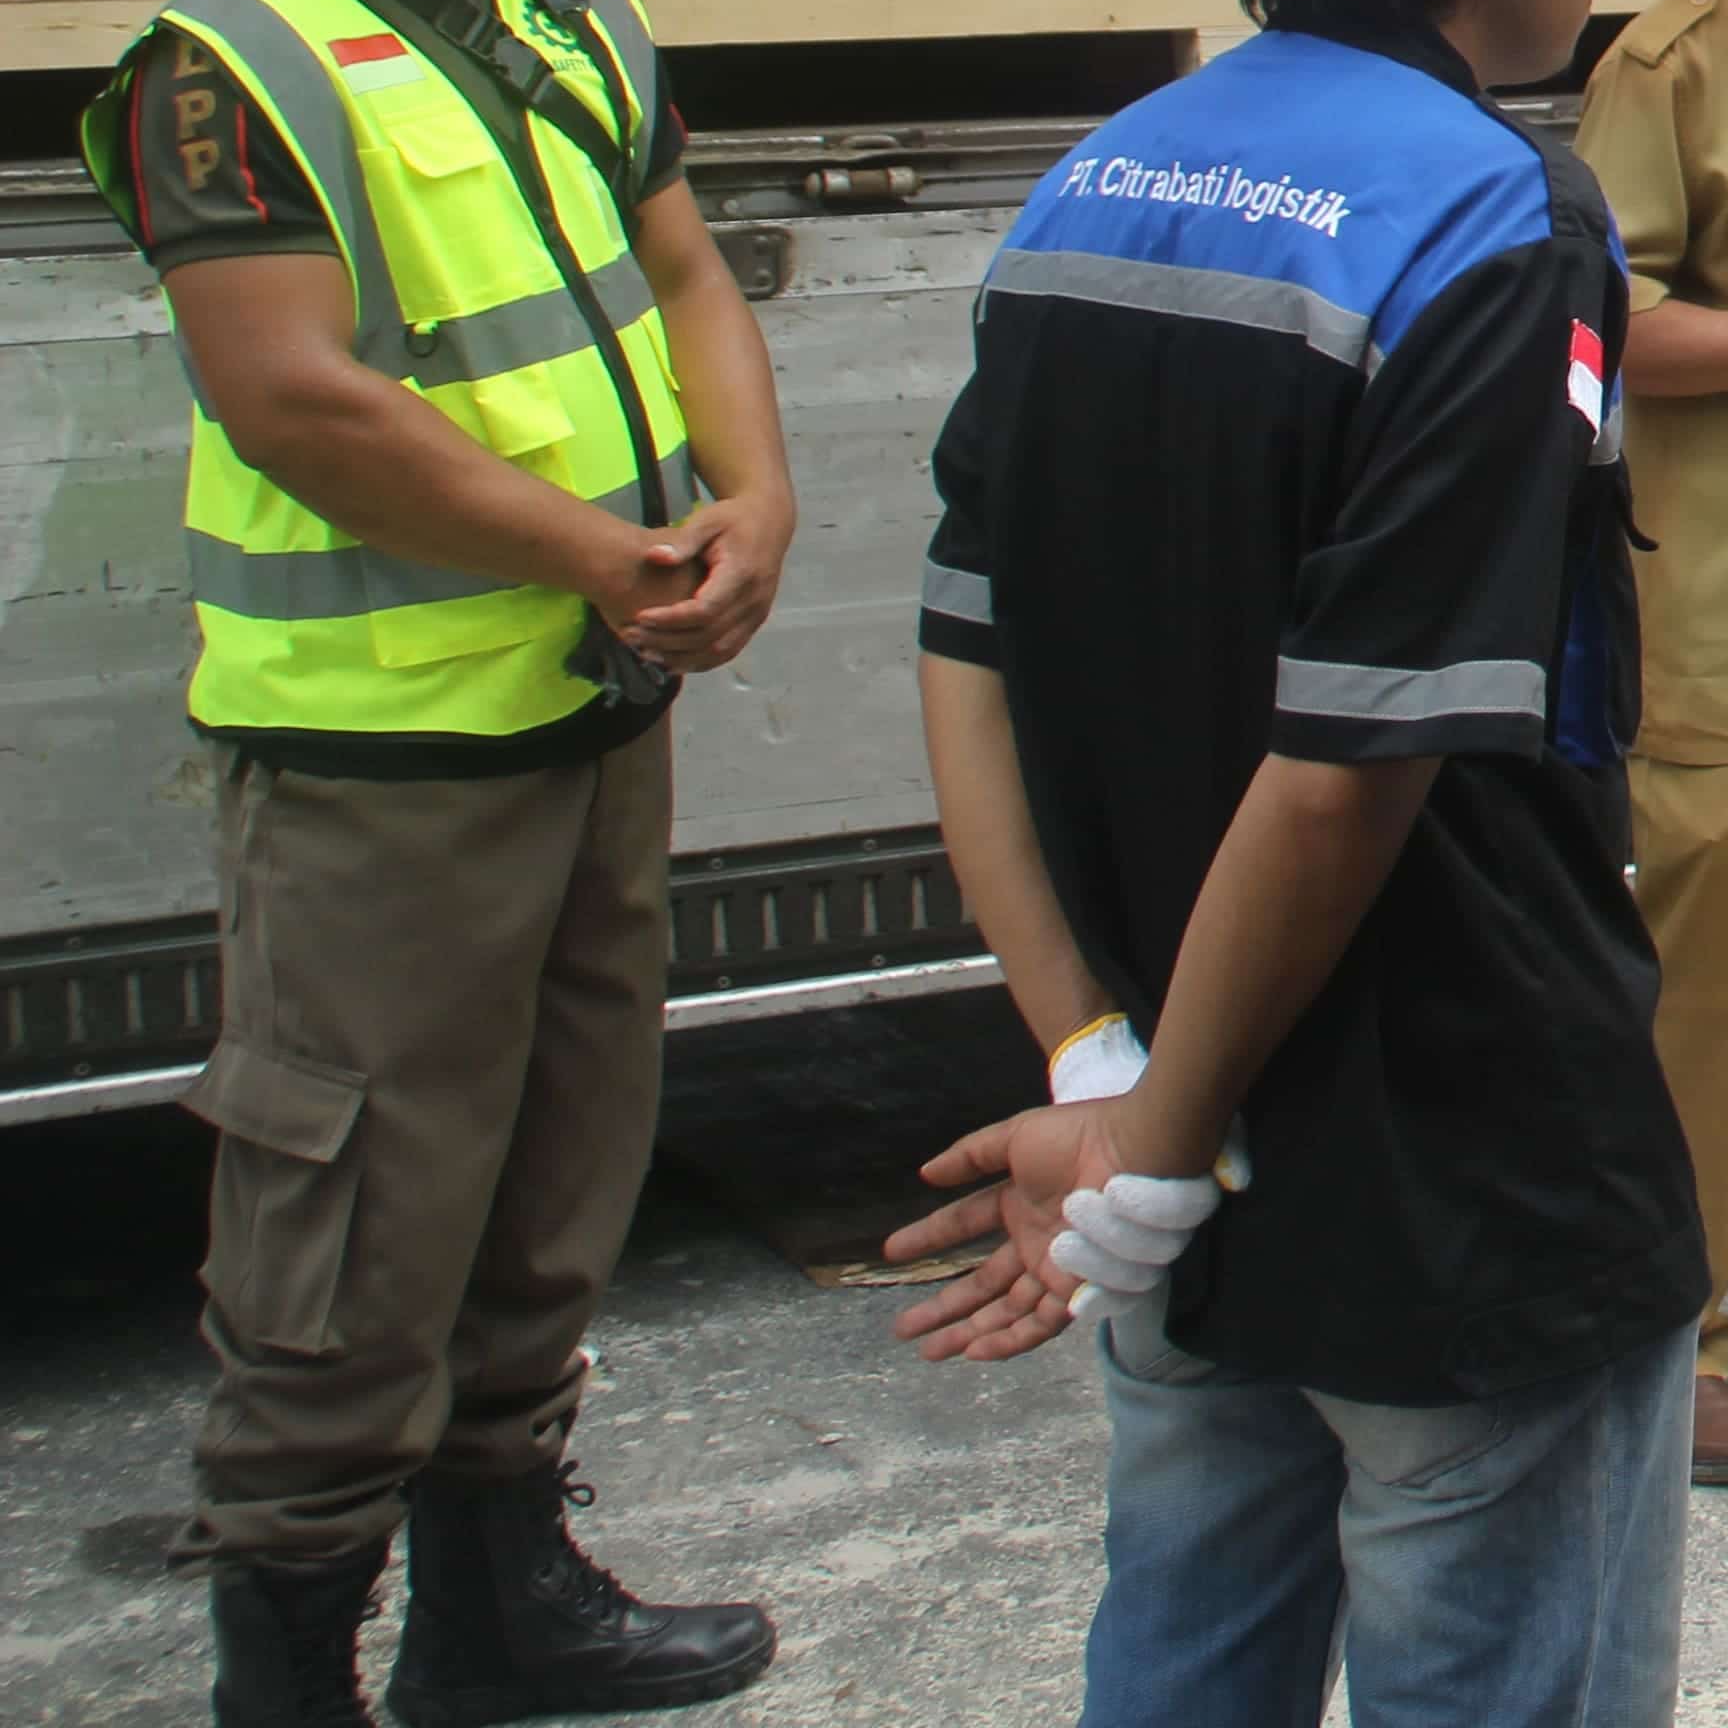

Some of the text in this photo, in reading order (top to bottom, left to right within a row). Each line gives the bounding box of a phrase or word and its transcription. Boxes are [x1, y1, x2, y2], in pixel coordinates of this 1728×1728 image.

[1057, 156, 1352, 238] PT. Citrabati logistik
